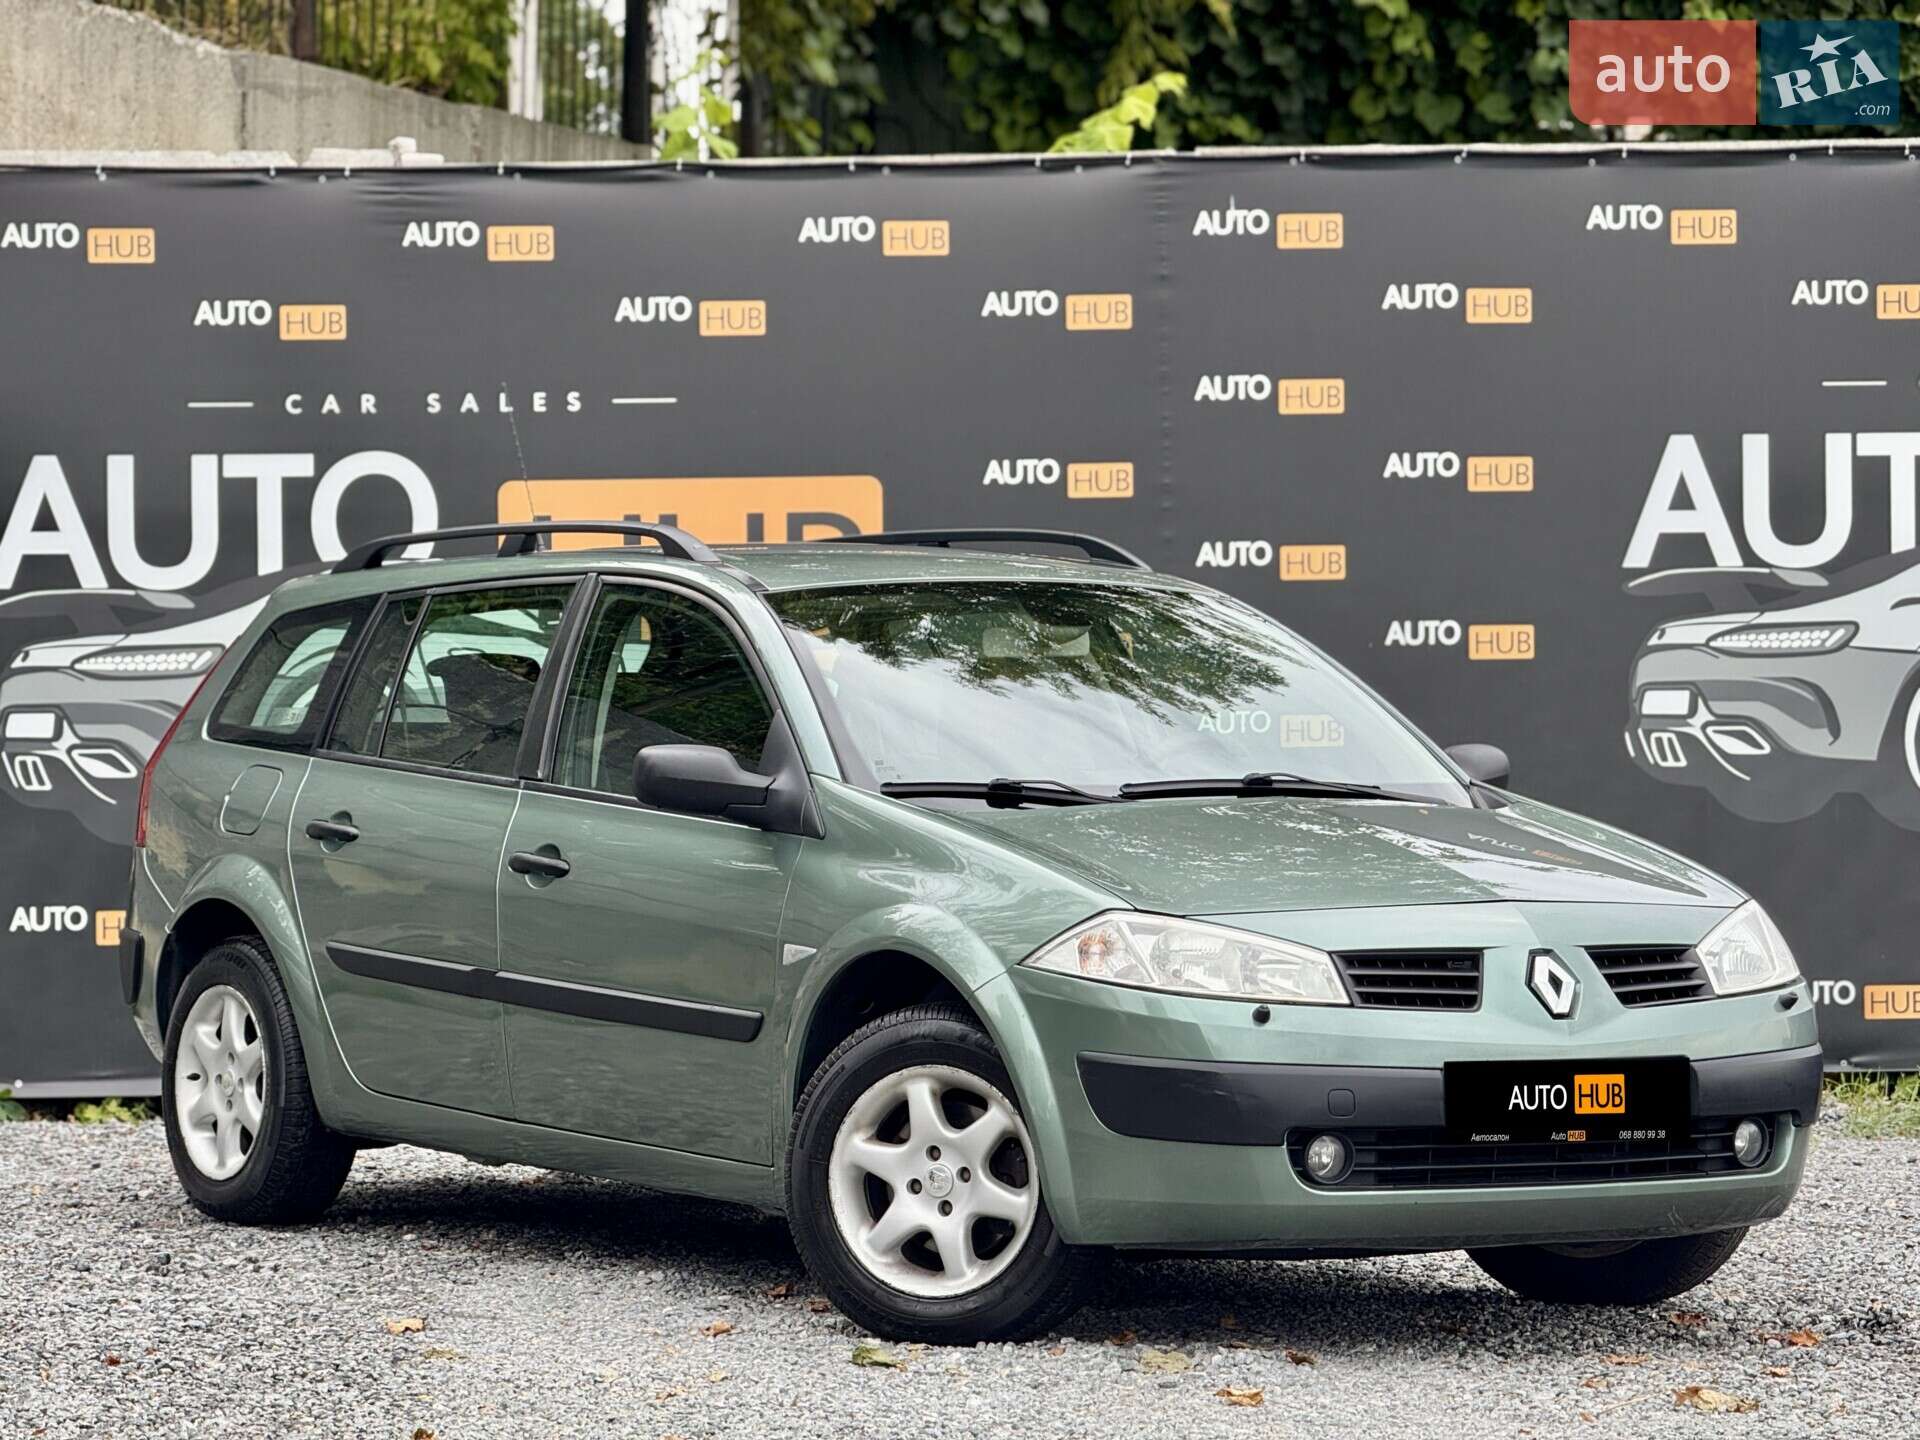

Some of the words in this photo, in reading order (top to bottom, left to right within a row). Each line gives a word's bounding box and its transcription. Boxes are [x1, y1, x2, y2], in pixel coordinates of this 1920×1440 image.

[402, 221, 480, 248] AUTO
[494, 234, 550, 256] HUB
[798, 216, 876, 243] AUTO
[889, 228, 946, 251] HUB
[1193, 209, 1270, 237] AUTO
[1284, 221, 1340, 243] HUB
[1586, 205, 1663, 230] AUTO
[1677, 216, 1733, 239] HUB
[1, 223, 79, 249] AUTO
[94, 235, 152, 258] HUB
[981, 290, 1059, 318] AUTO
[1073, 301, 1130, 325] HUB
[1382, 283, 1459, 310] AUTO
[1473, 294, 1529, 318] HUB
[1792, 280, 1869, 305] AUTO
[194, 300, 272, 327] AUTO
[286, 311, 343, 335] HUB
[615, 296, 692, 323] AUTO
[706, 307, 763, 331] HUB
[285, 394, 377, 415] CAR
[427, 391, 582, 413] SALES
[1194, 375, 1271, 402] AUTO
[1286, 385, 1342, 409] HUB
[983, 459, 1060, 485] AUTO
[1074, 469, 1131, 494] HUB
[1383, 452, 1460, 479] AUTO
[1474, 463, 1530, 487] HUB
[0, 450, 439, 590] AUTO
[1196, 541, 1272, 568] AUTO
[1287, 552, 1343, 576] HUB
[1385, 620, 1461, 646] AUTO
[1476, 631, 1532, 654] HUB
[9, 905, 88, 932] AUTO
[1508, 1084, 1568, 1110] AUTO
[1578, 1083, 1623, 1109] HUB
[1551, 1131, 1566, 1140] Auto
[1569, 1131, 1585, 1140] HUB
[1619, 1130, 1632, 1139] 068
[1633, 1130, 1646, 1139] 880
[1647, 1130, 1656, 1139] 99
[1657, 1130, 1666, 1139] 38
